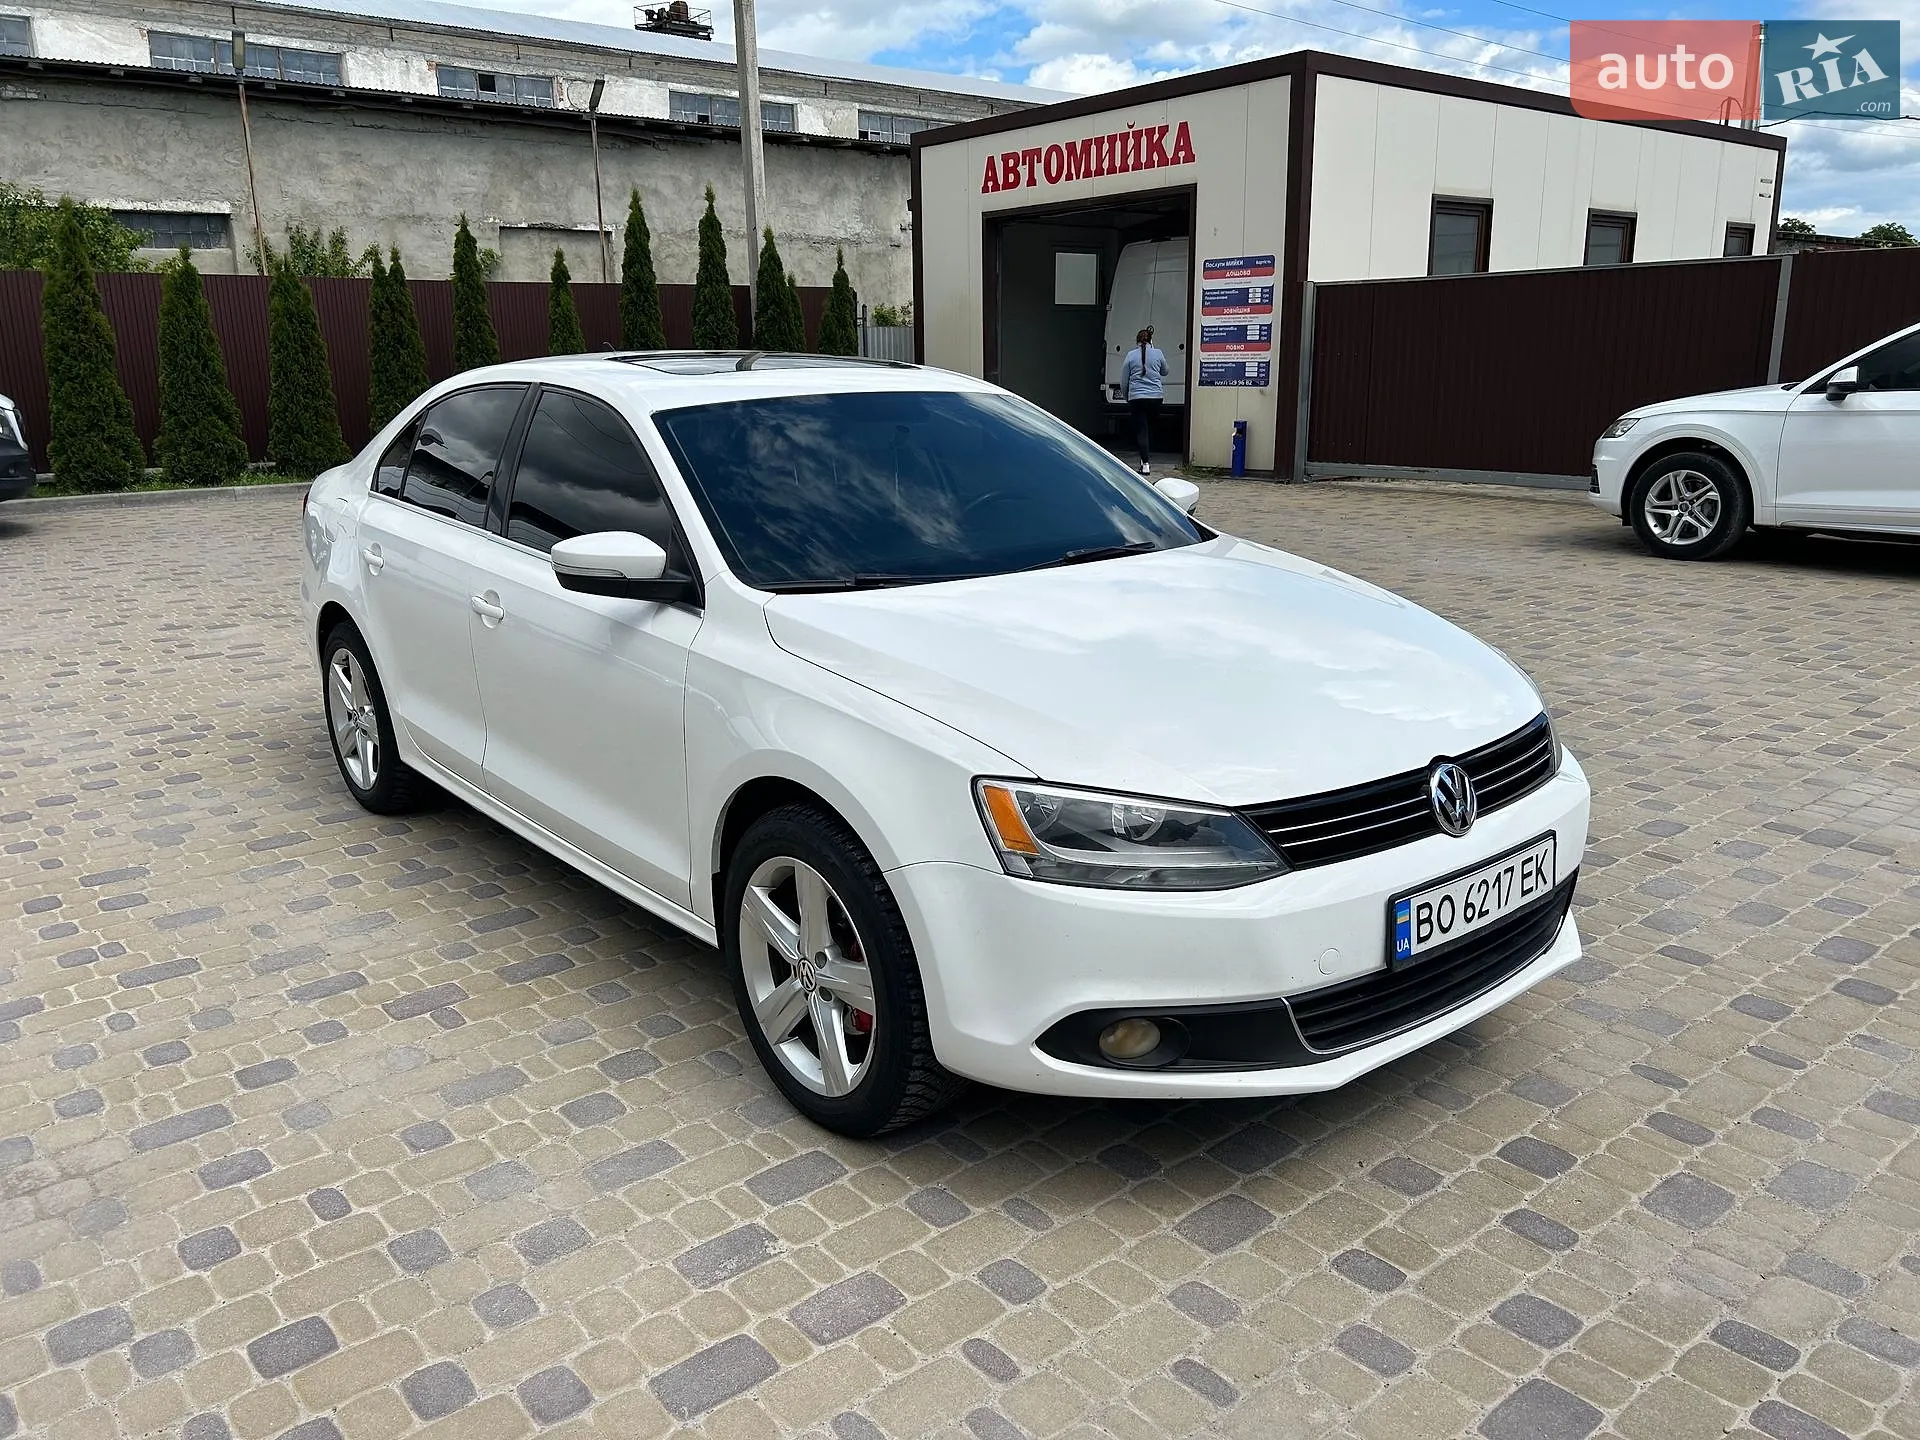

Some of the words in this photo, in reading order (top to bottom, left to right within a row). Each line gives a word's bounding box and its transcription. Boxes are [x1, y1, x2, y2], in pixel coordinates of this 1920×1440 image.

[981, 120, 1196, 194] АВТОМИЙКА
[1416, 894, 1456, 945] BO
[1463, 865, 1514, 923] 6217
[1520, 848, 1549, 898] EK
[1397, 939, 1410, 953] UA
